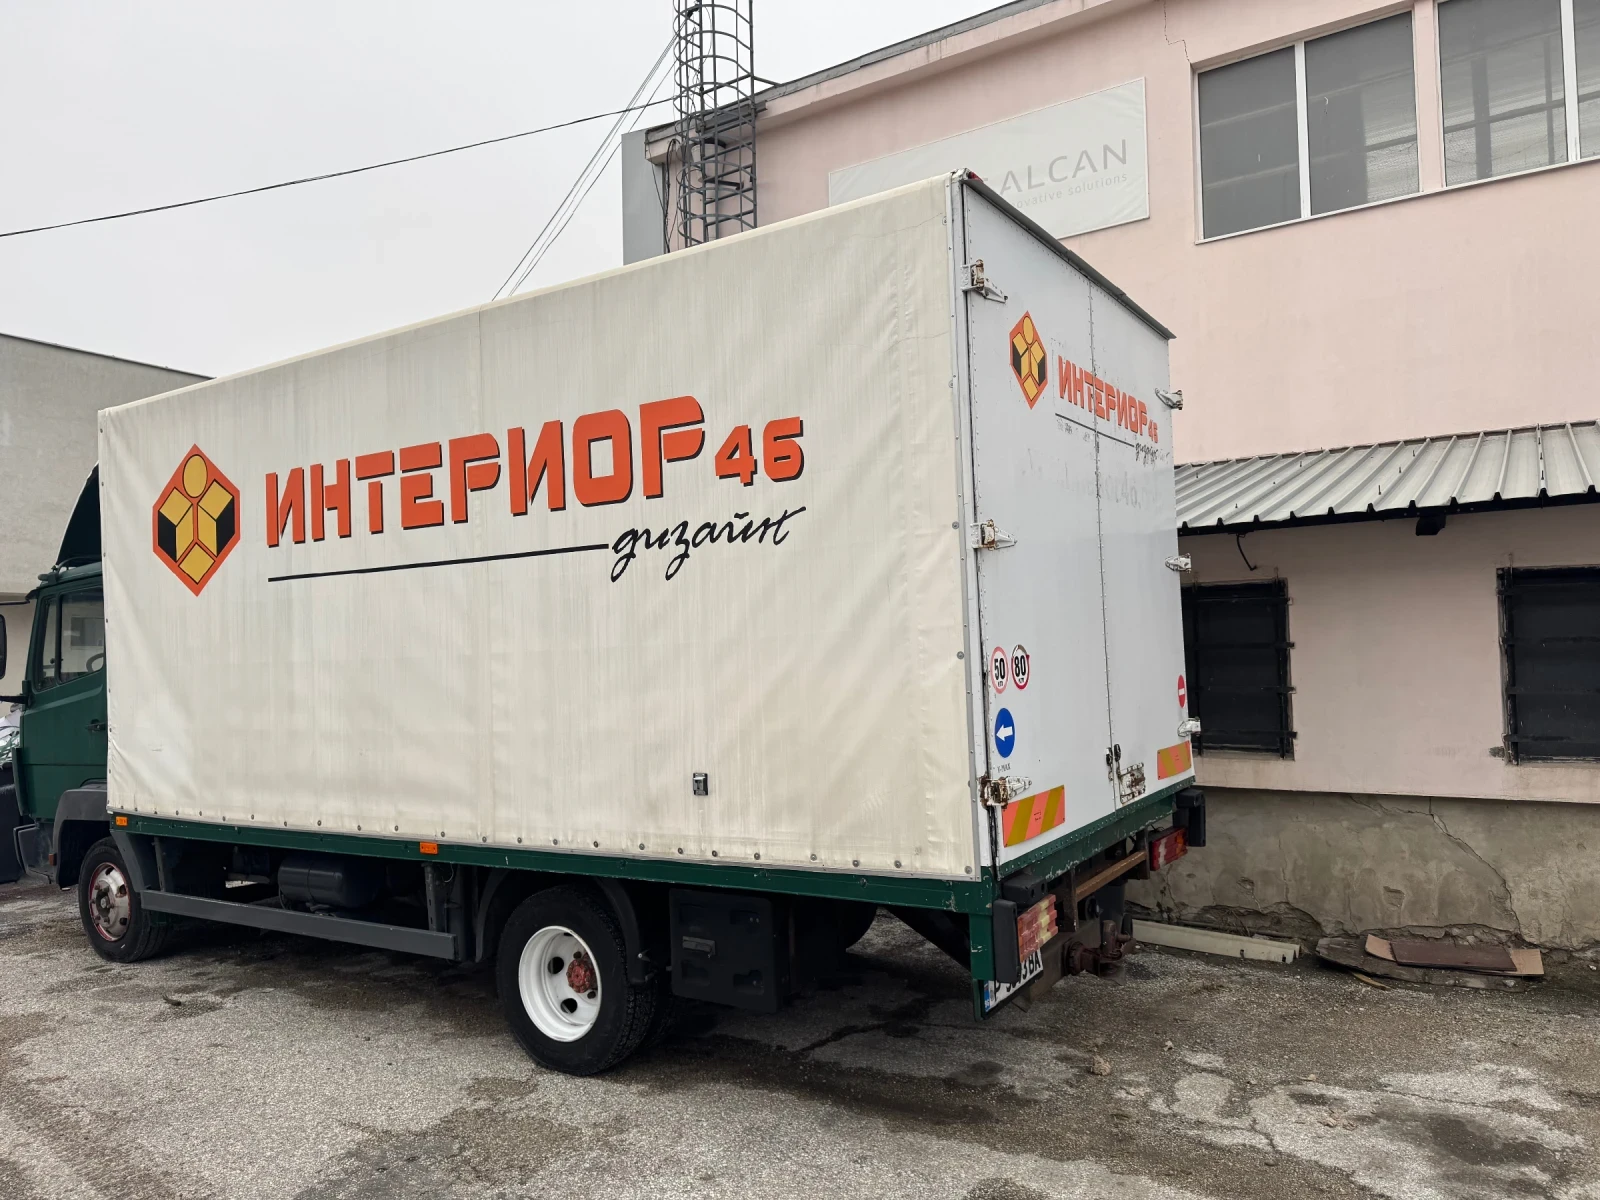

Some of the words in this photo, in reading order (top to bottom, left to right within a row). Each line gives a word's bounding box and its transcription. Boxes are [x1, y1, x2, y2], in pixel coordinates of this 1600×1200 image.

[984, 139, 1127, 195] ALCAN
[1068, 173, 1128, 196] solutions
[1058, 354, 1147, 436] ИНТЕРИОР
[1148, 419, 1158, 443] 46
[265, 395, 705, 548] ИНТЕРИОР
[714, 416, 804, 487] 46
[610, 506, 807, 582] дизайн
[994, 657, 1006, 680] 50
[1014, 655, 1026, 677] 80
